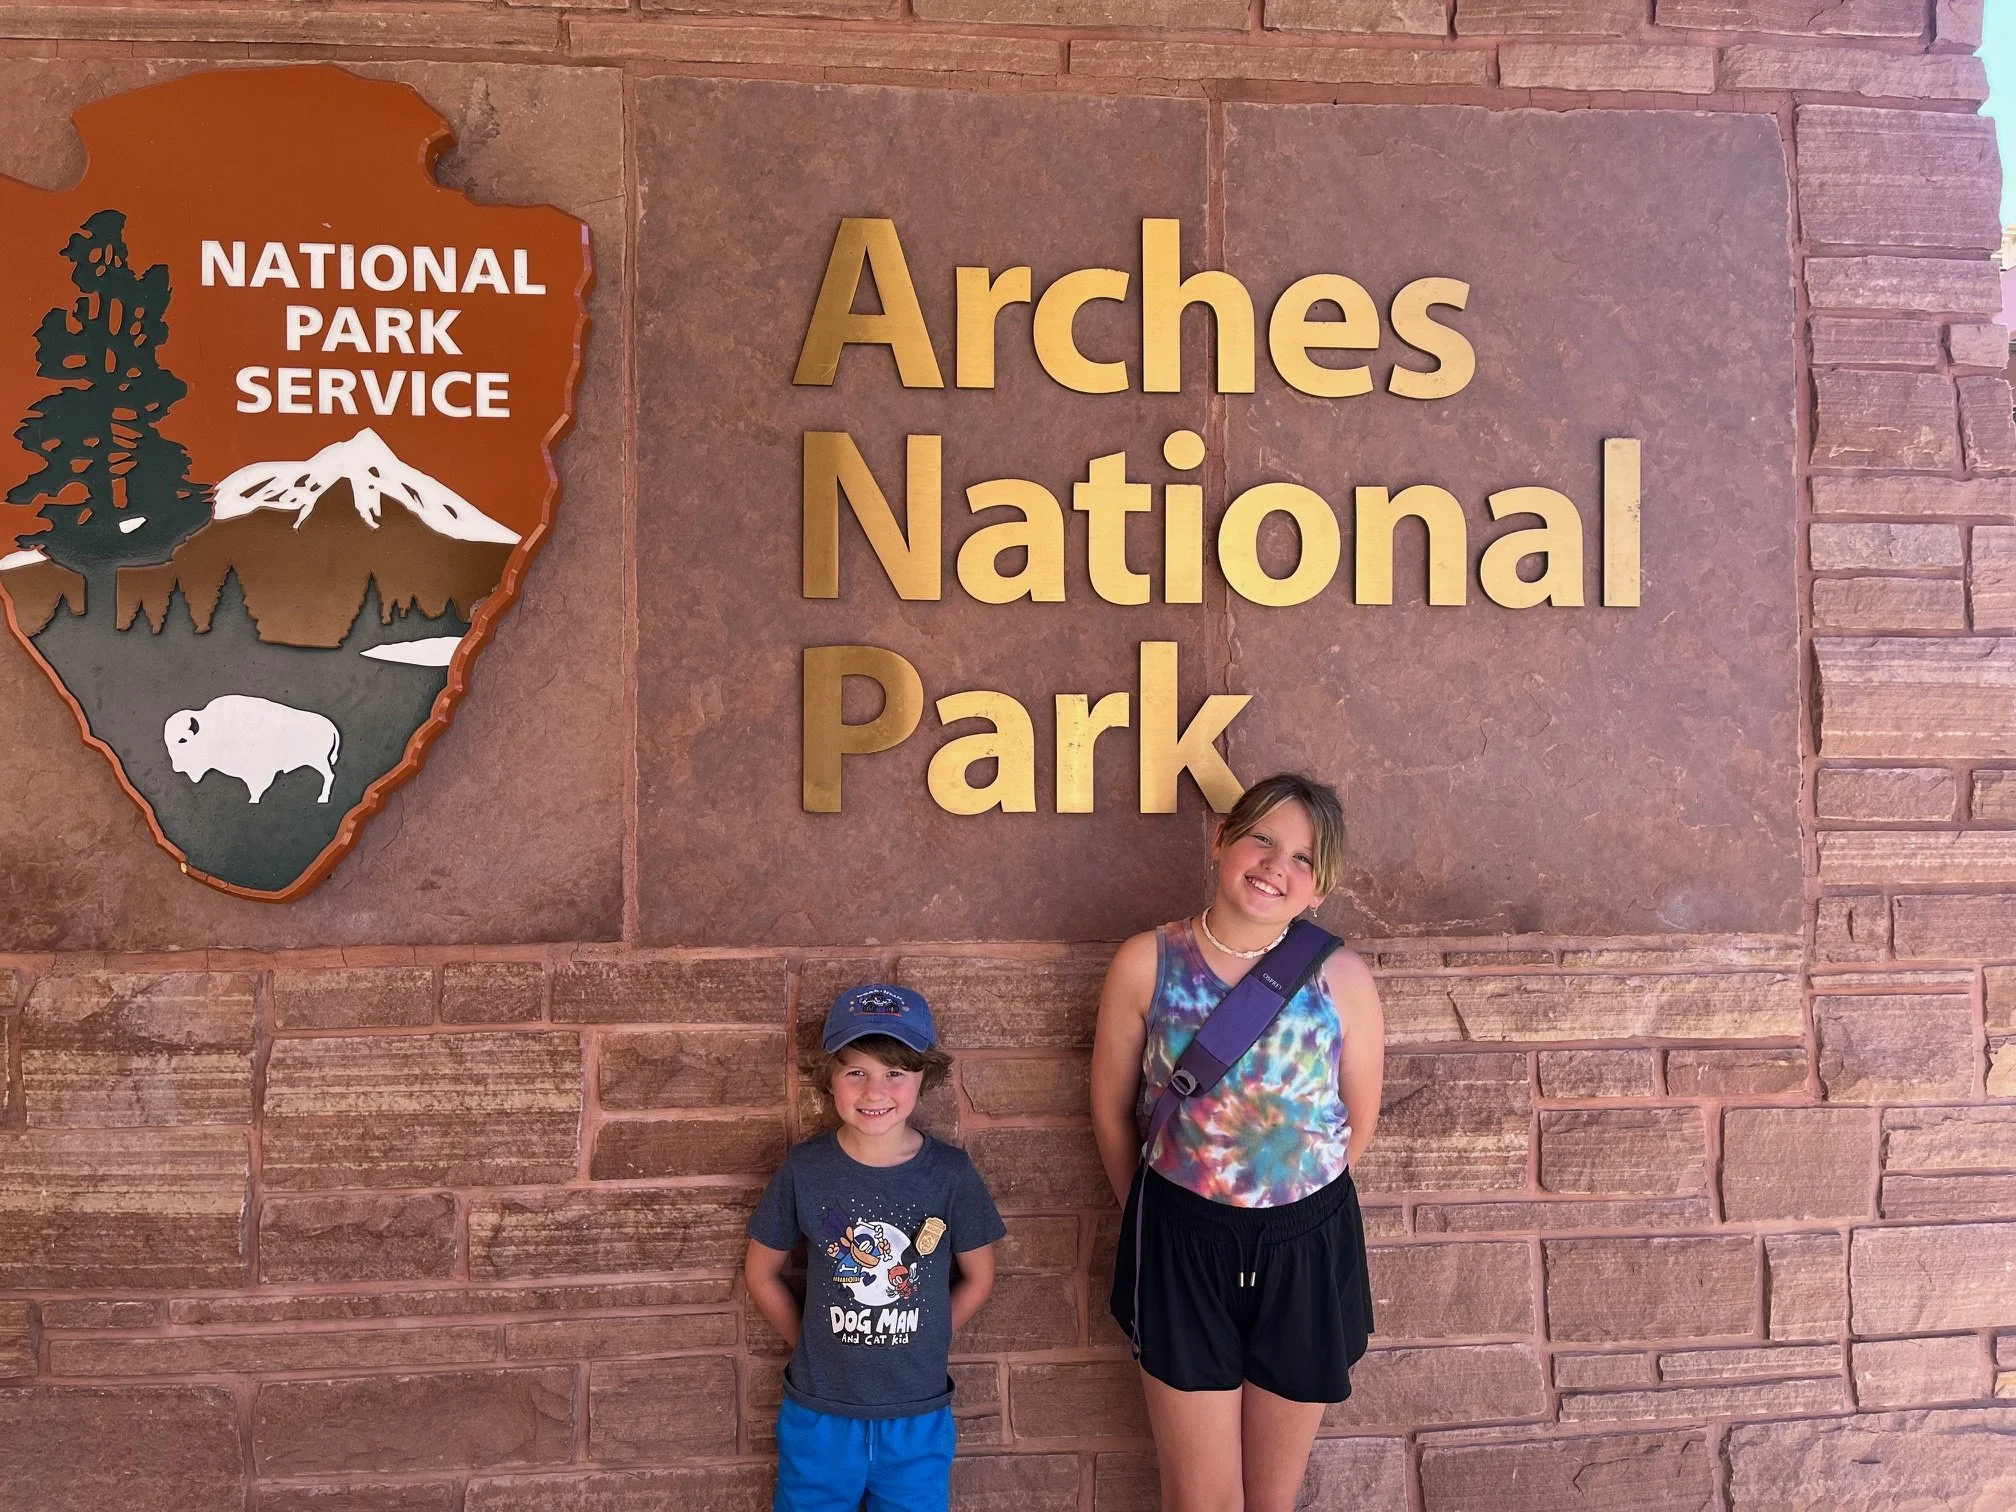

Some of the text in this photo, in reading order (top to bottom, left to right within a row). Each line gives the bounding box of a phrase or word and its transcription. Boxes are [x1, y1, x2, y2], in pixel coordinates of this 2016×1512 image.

[201, 240, 546, 295] NATIONAL
[286, 305, 463, 355] PARK
[792, 217, 1476, 399] Arches
[235, 366, 510, 418] SERVICE
[803, 429, 1641, 608] National
[803, 641, 1253, 815] Park
[830, 1306, 919, 1334] DOG MAN
[864, 1334, 887, 1345] CAT
